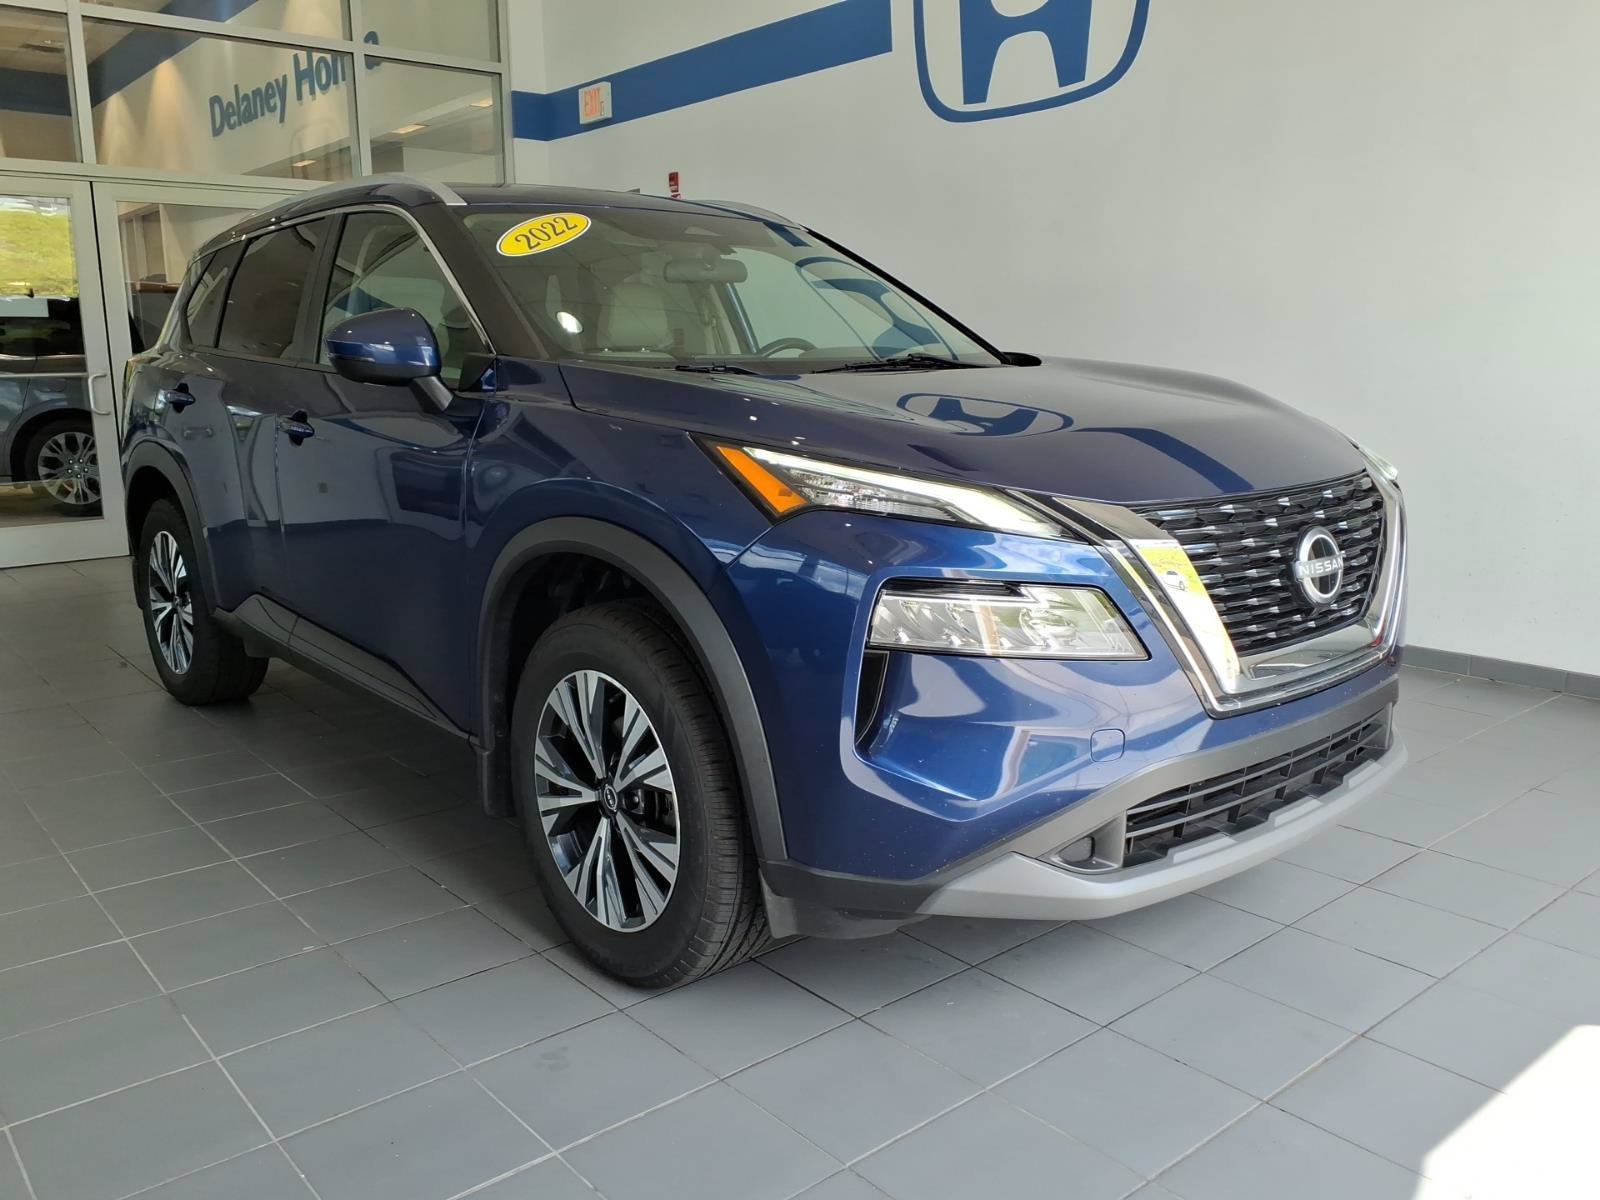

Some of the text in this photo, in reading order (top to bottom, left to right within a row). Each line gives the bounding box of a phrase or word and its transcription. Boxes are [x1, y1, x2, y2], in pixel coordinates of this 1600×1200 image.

[209, 31, 381, 137] Delaney Hona
[584, 87, 601, 117] EXIT
[515, 217, 577, 250] 2022
[1300, 558, 1343, 576] NISSAN
